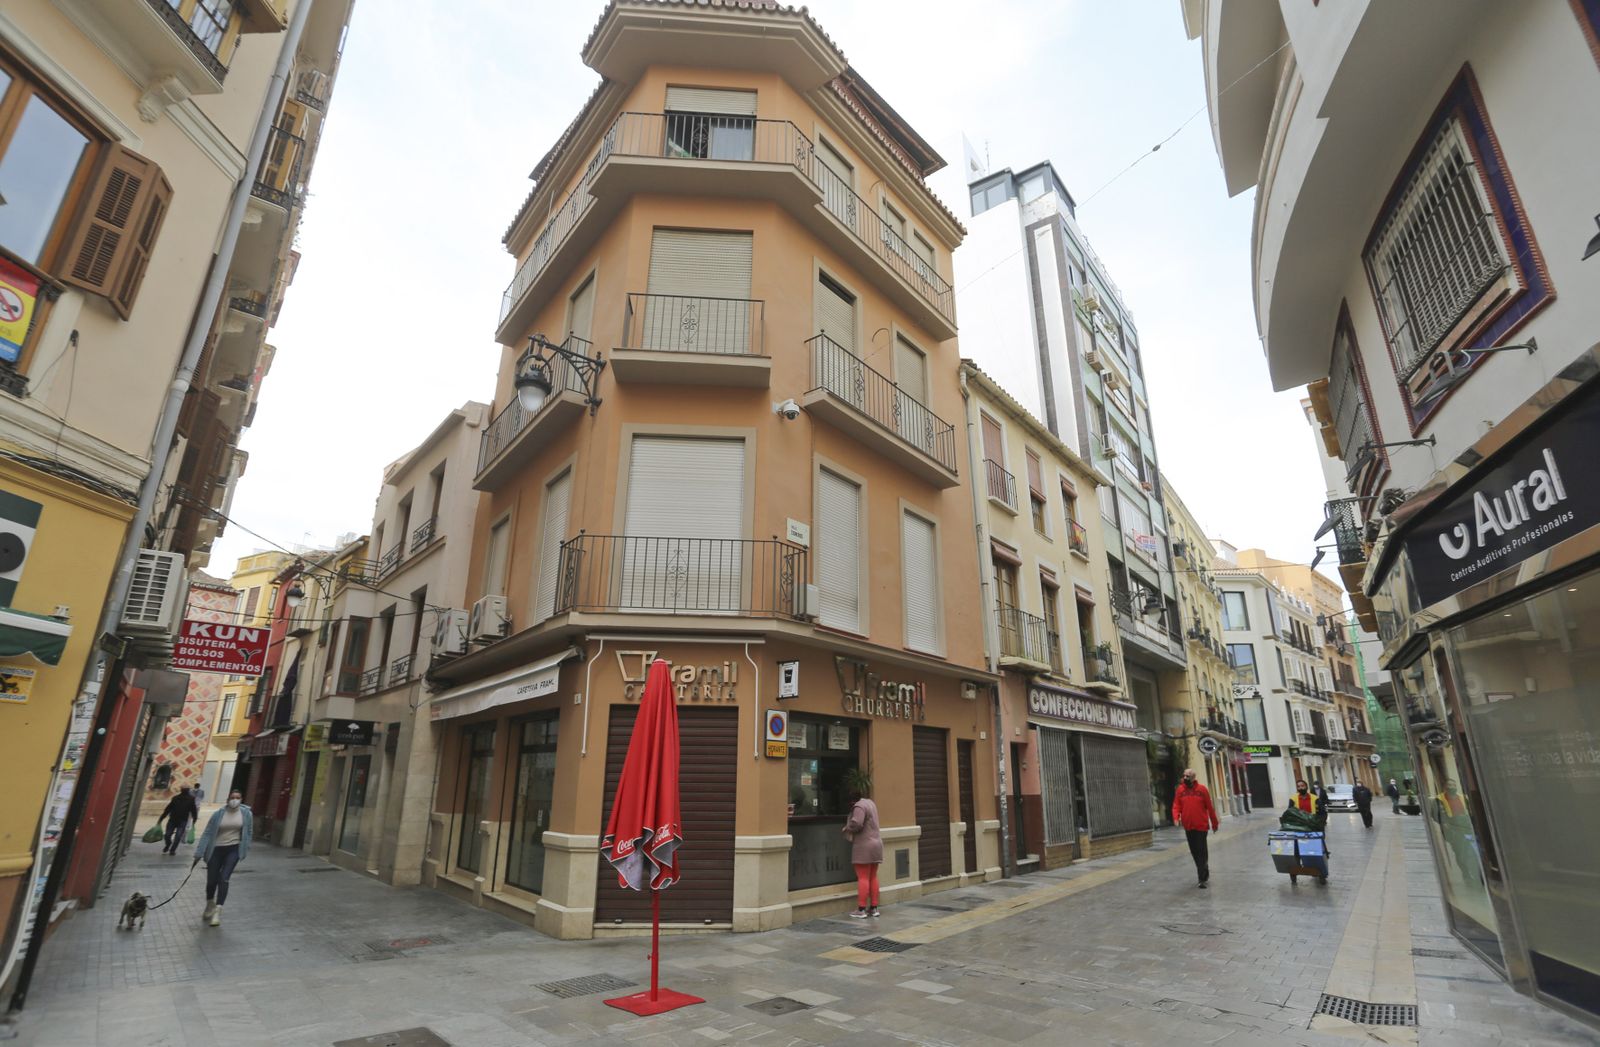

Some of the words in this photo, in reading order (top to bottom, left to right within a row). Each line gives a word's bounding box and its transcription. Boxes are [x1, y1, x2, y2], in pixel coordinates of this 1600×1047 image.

[1473, 448, 1567, 547] Aural
[1450, 564, 1477, 582] Centros
[1477, 544, 1512, 569] Auditivos
[1512, 510, 1574, 549] Profesionales
[189, 622, 260, 643] KUN
[178, 636, 237, 650] BISUTERIA
[179, 647, 225, 659] BOLSOS
[172, 657, 261, 672] COMPLEMENTOS
[624, 683, 736, 700] CATERIA
[1029, 688, 1109, 725] CONFECCIONES
